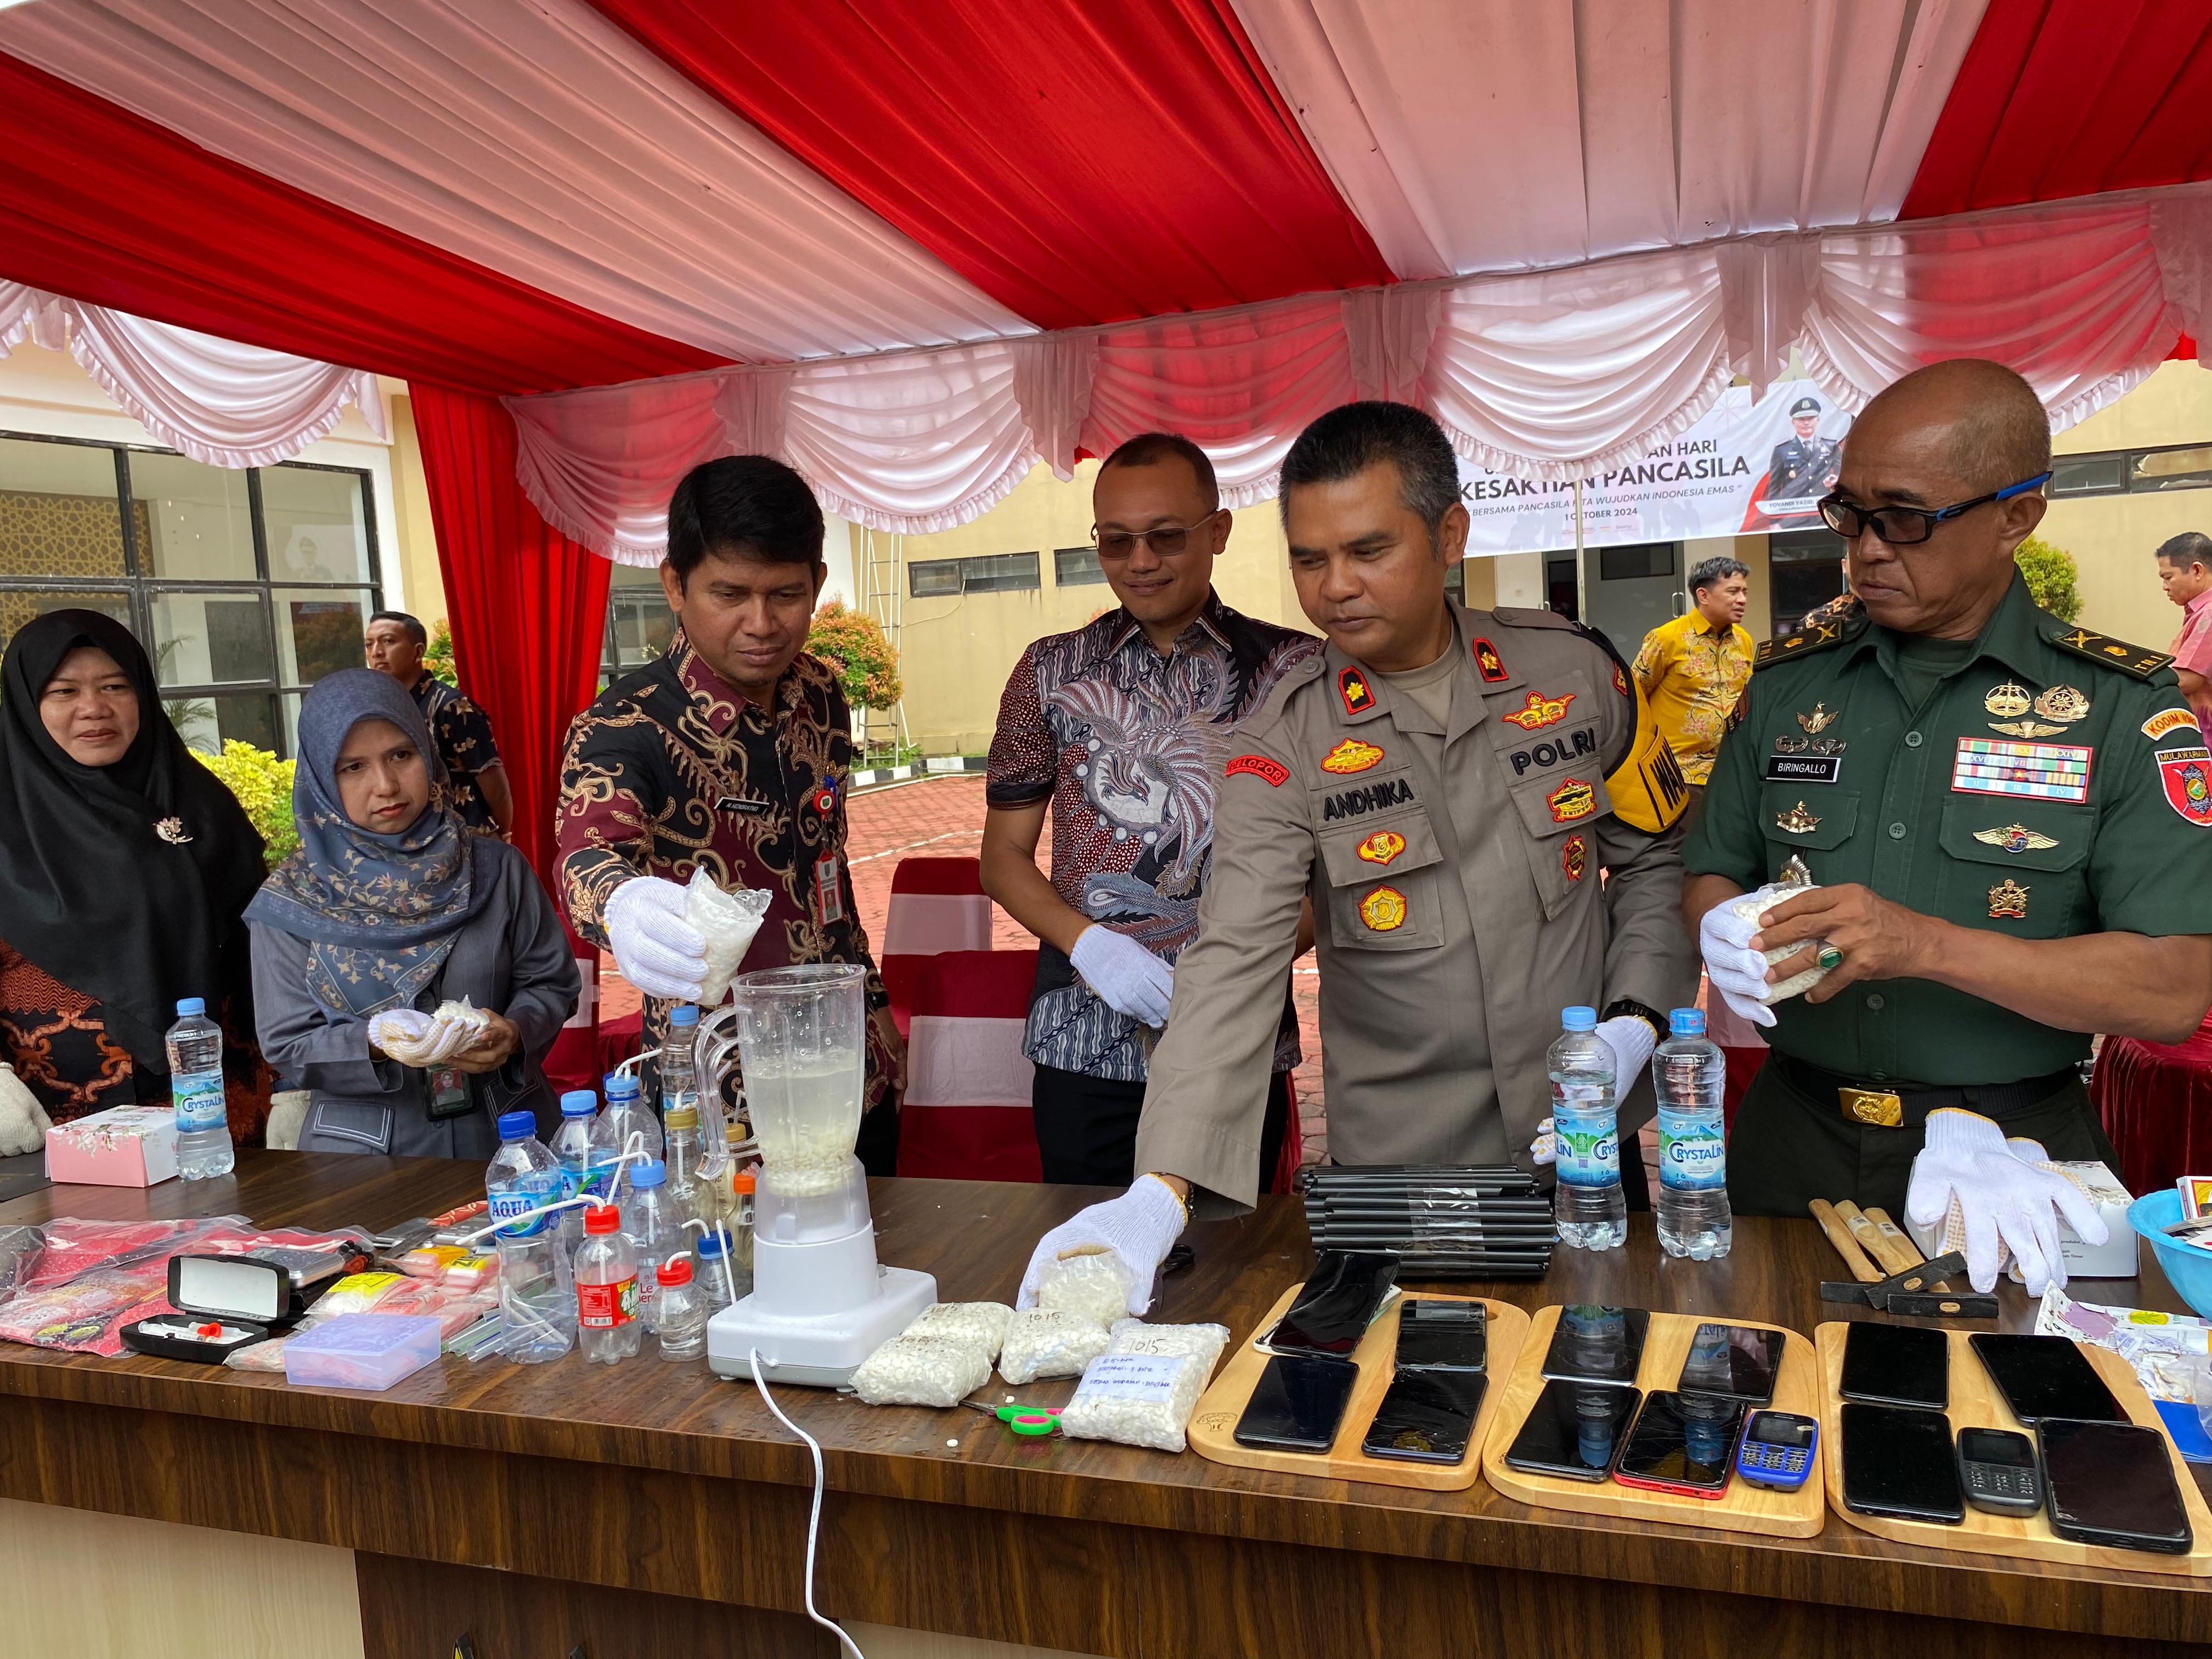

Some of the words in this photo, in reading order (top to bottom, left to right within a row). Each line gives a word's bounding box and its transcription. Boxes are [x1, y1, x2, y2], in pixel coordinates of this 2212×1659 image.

[1677, 439, 1717, 456] HARI
[1604, 455, 1751, 488] PANCASILA
[1472, 506, 1515, 517] BERSAMA
[1517, 500, 1570, 512] PANCASILA
[1572, 497, 1593, 507] KTA
[1595, 493, 1650, 505] WUJUDKAN
[1652, 487, 1704, 500] INDONESIA
[1707, 485, 1735, 495] EMAS
[1570, 509, 1611, 521] OTOBER
[1614, 507, 1638, 518] 2024
[2148, 713, 2180, 735] KODIM
[1511, 727, 1596, 776] POLRI
[2159, 750, 2209, 763] MULAWARMAN
[1777, 763, 1826, 774] BIRINGALLO
[1323, 778, 1414, 821] ANDHIKA
[492, 1199, 534, 1218] AQUA
[640, 1283, 653, 1294] Le
[1030, 1311, 1063, 1323] 1015
[1127, 1339, 1165, 1355] 1015
